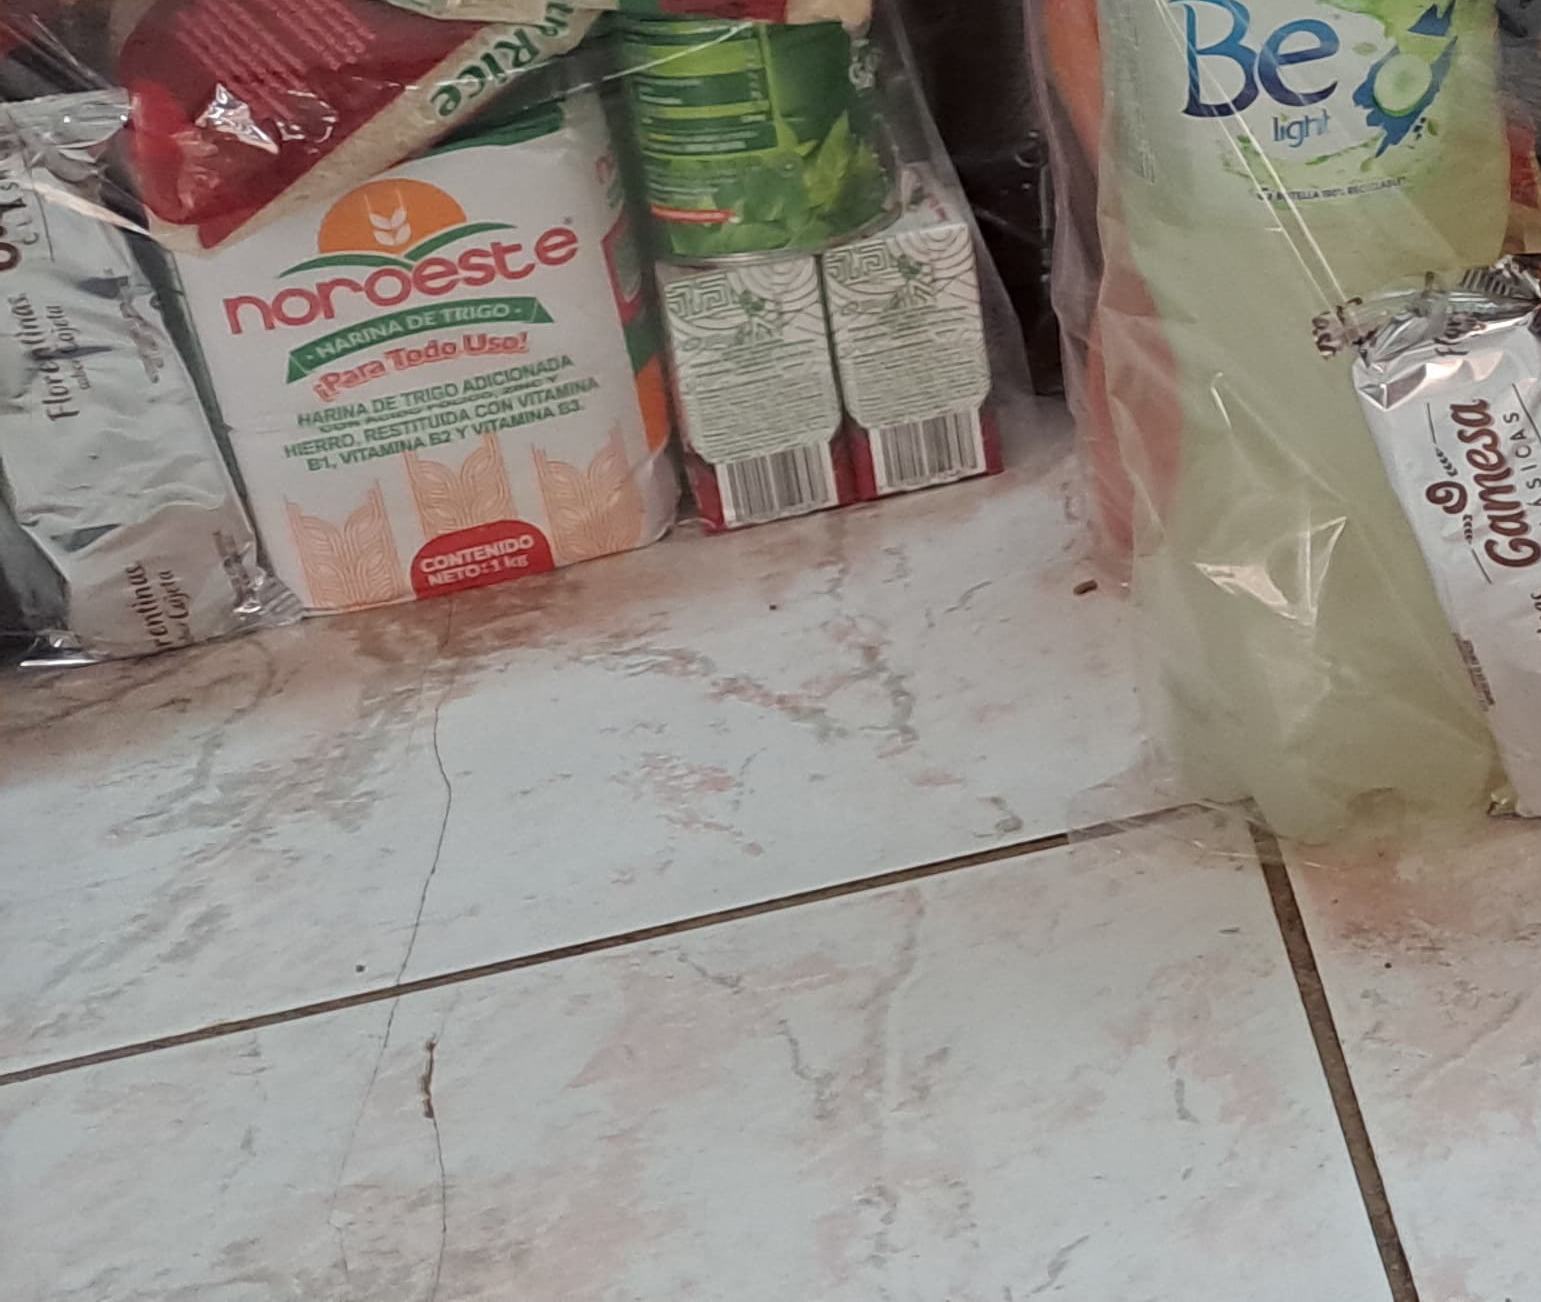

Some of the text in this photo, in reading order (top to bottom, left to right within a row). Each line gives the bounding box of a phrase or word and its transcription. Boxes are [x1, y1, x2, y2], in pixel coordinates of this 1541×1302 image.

[430, 26, 538, 117] Rice
[1271, 108, 1331, 148] light
[223, 227, 580, 336] noroeste
[315, 301, 512, 359] HARINA DE TRIGO
[296, 354, 575, 429] HARINA DE TRIGO ADICIONADA
[310, 331, 530, 402] ¡Para Todo Uso!
[306, 455, 338, 472] B1,
[338, 435, 427, 466] VITAMINA
[428, 430, 452, 448] B2
[453, 426, 468, 443] Y
[470, 407, 556, 438] VITAMINA
[364, 407, 471, 444] RESTITUIDA
[475, 397, 514, 420] CON
[517, 375, 600, 407] VITAMINA
[420, 534, 535, 575] CONTENIDO
